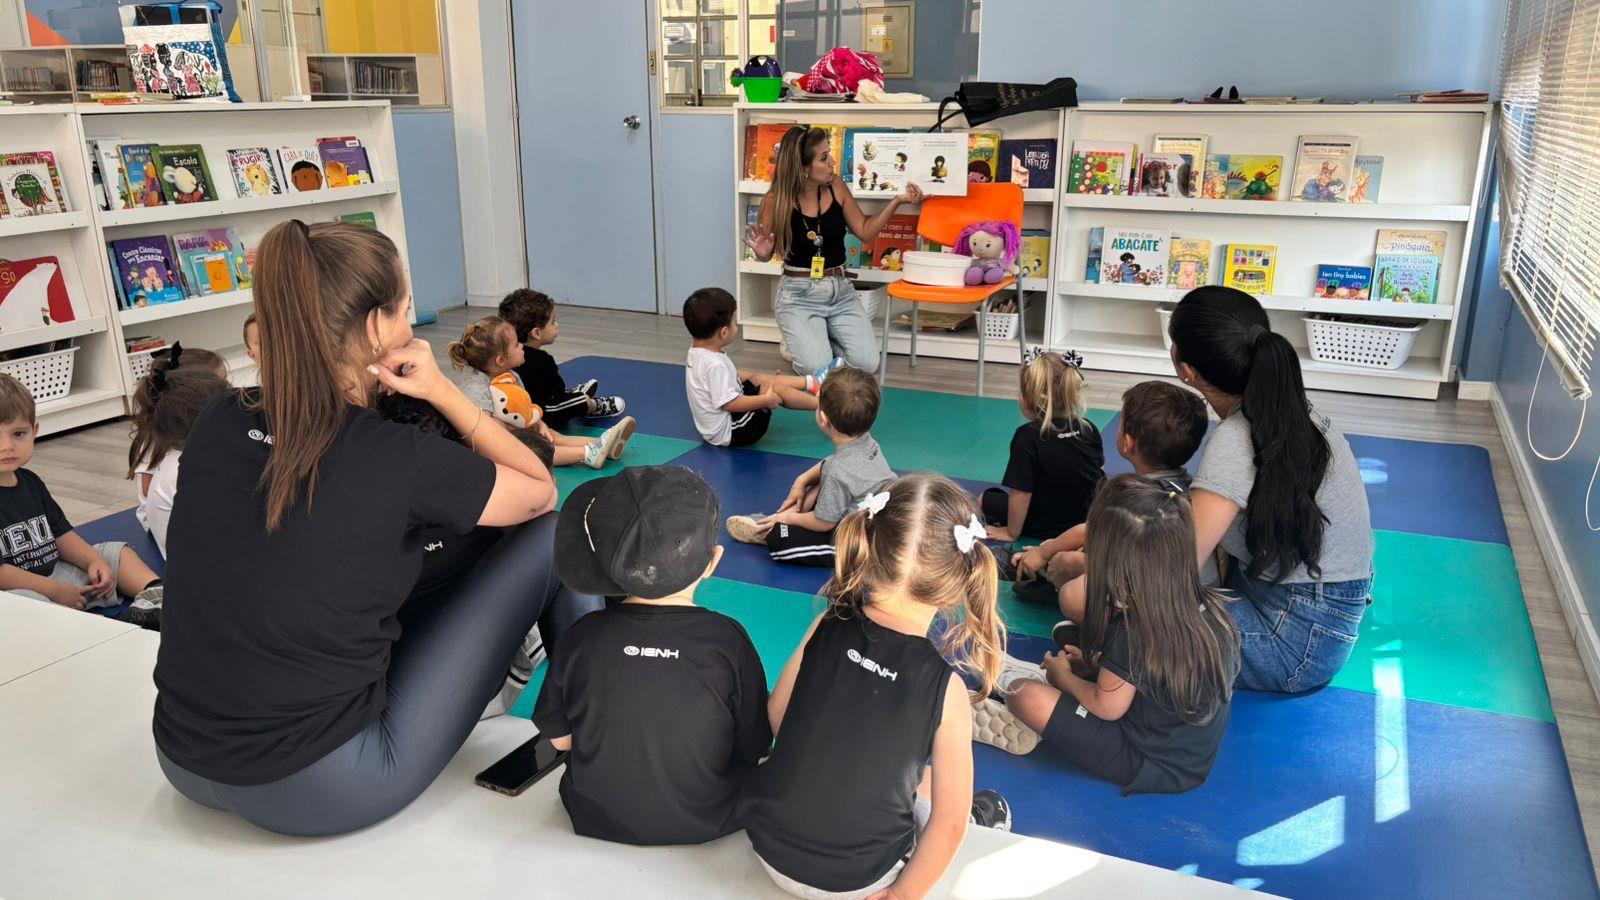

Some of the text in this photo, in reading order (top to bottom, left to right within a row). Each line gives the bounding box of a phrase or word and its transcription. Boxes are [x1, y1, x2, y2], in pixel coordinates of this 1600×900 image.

[173, 156, 198, 166] Escola
[239, 154, 264, 165] RUGIR!
[1354, 158, 1381, 167] laytime
[1111, 238, 1160, 252] ABACATE
[135, 254, 165, 264] Encantar
[1333, 271, 1345, 280] tiny
[1345, 271, 1366, 280] babies
[640, 647, 679, 659] IENH
[860, 656, 898, 682] IENH
